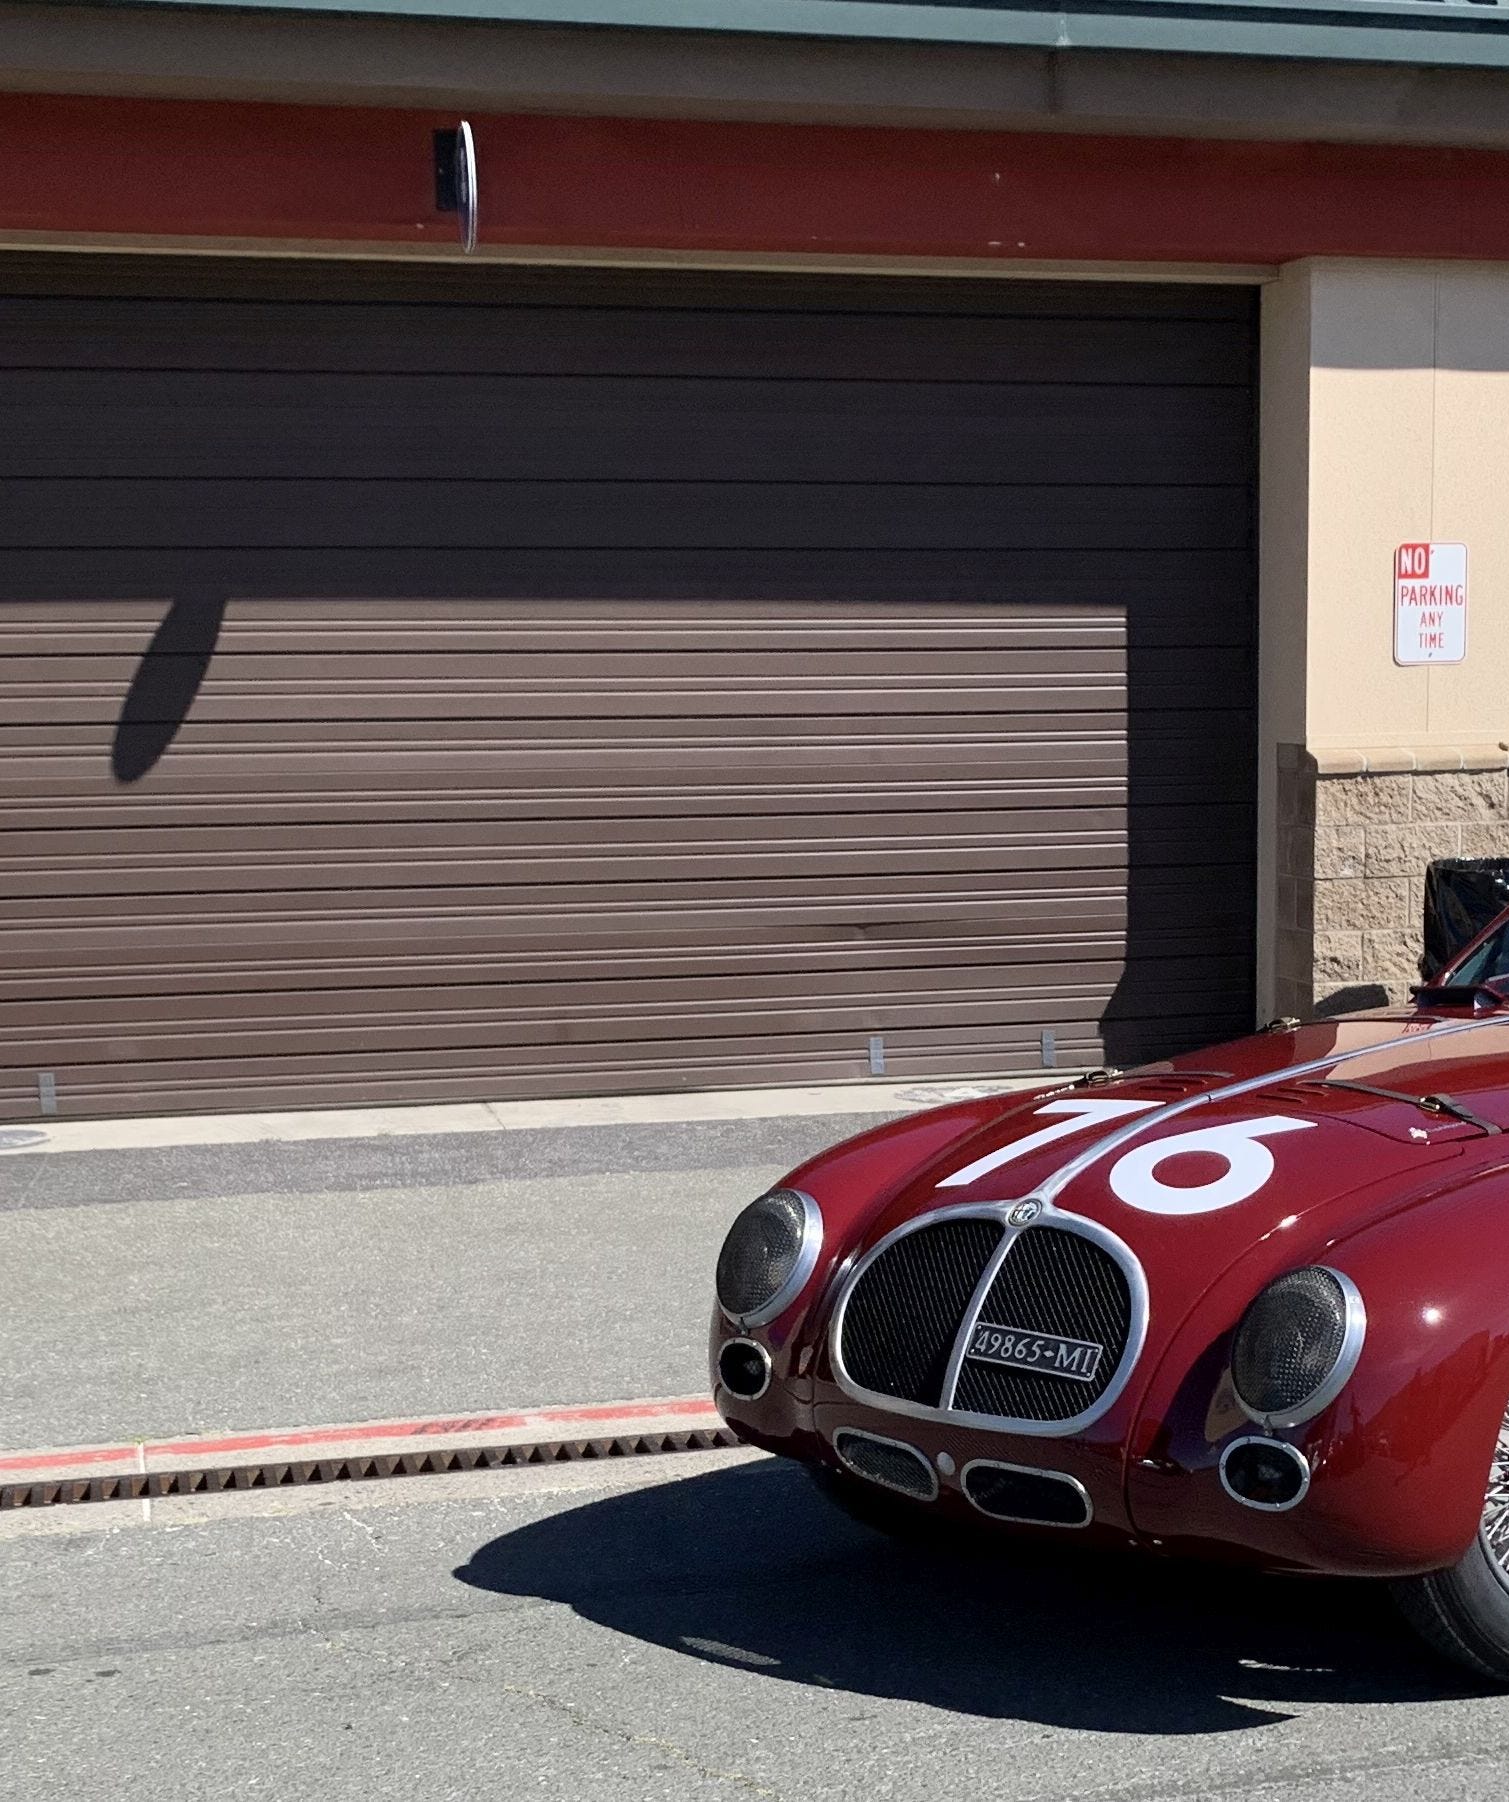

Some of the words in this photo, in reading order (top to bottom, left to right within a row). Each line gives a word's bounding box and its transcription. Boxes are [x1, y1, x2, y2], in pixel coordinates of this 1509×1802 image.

[1400, 547, 1427, 575] NO
[1400, 584, 1464, 607] PARKING
[1419, 611, 1444, 628] ANY
[1418, 632, 1445, 649] TIME
[934, 1098, 1319, 1216] 76
